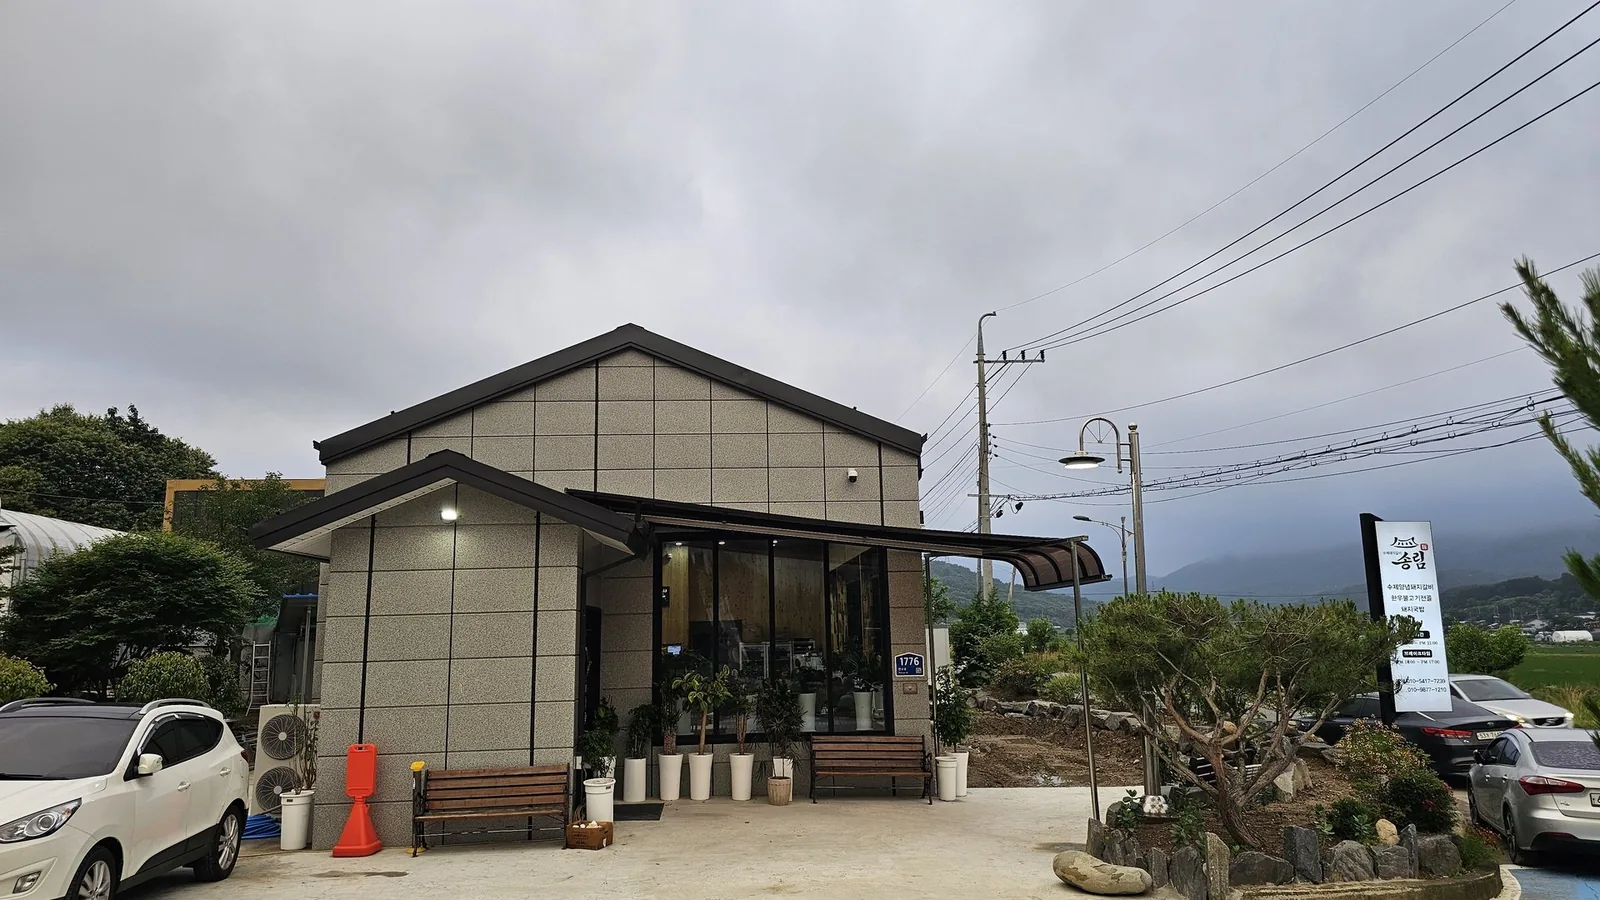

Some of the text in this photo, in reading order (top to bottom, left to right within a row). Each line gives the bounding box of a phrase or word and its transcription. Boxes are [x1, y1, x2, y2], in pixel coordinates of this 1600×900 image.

[1391, 550, 1426, 570] 송림
[1391, 594, 1432, 602] 한우불고기전골
[899, 657, 920, 666] 1776
